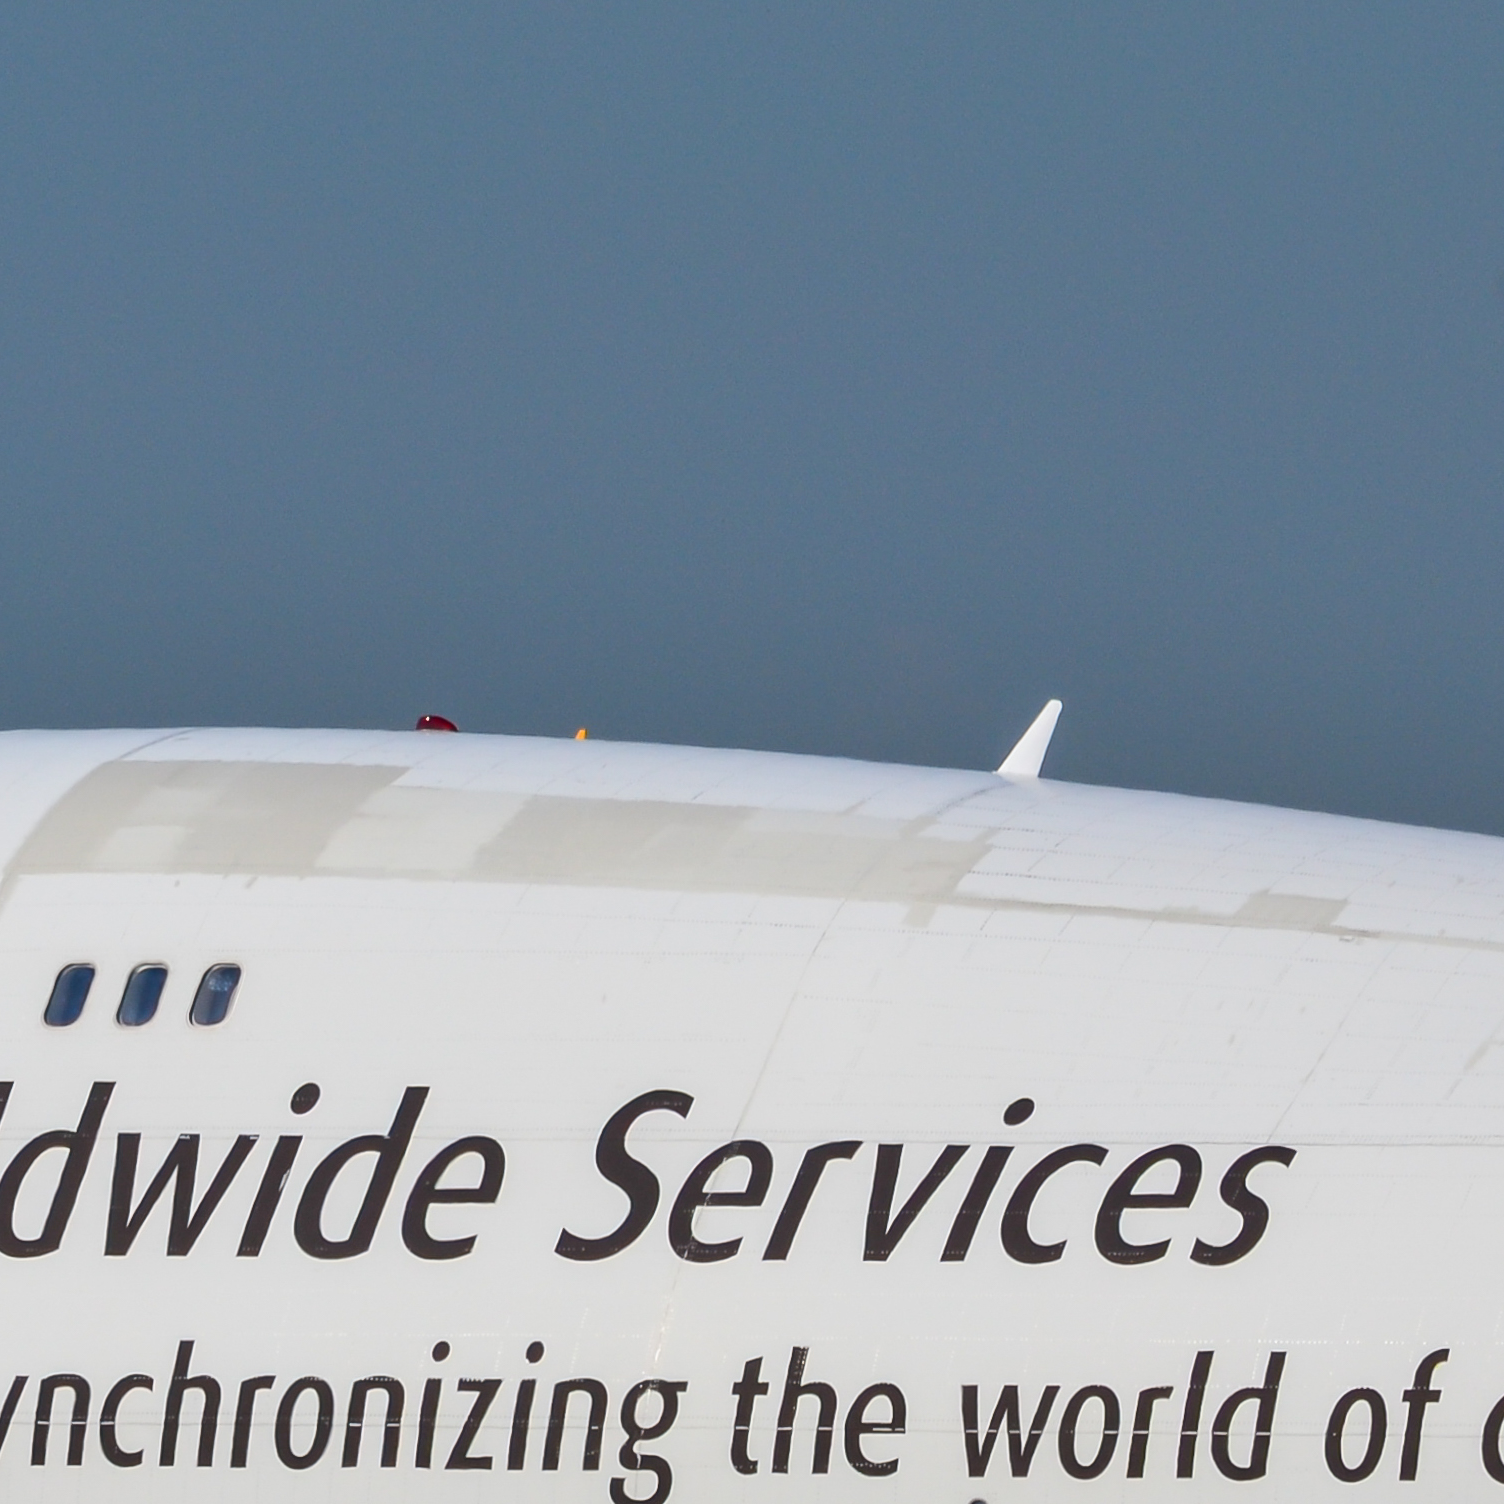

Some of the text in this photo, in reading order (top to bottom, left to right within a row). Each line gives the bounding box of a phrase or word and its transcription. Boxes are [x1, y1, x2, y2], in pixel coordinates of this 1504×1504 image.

[555, 1090, 1297, 1266] Services
[730, 1346, 907, 1477] the
[961, 1349, 1287, 1481] world
[1324, 1348, 1450, 1485] of
